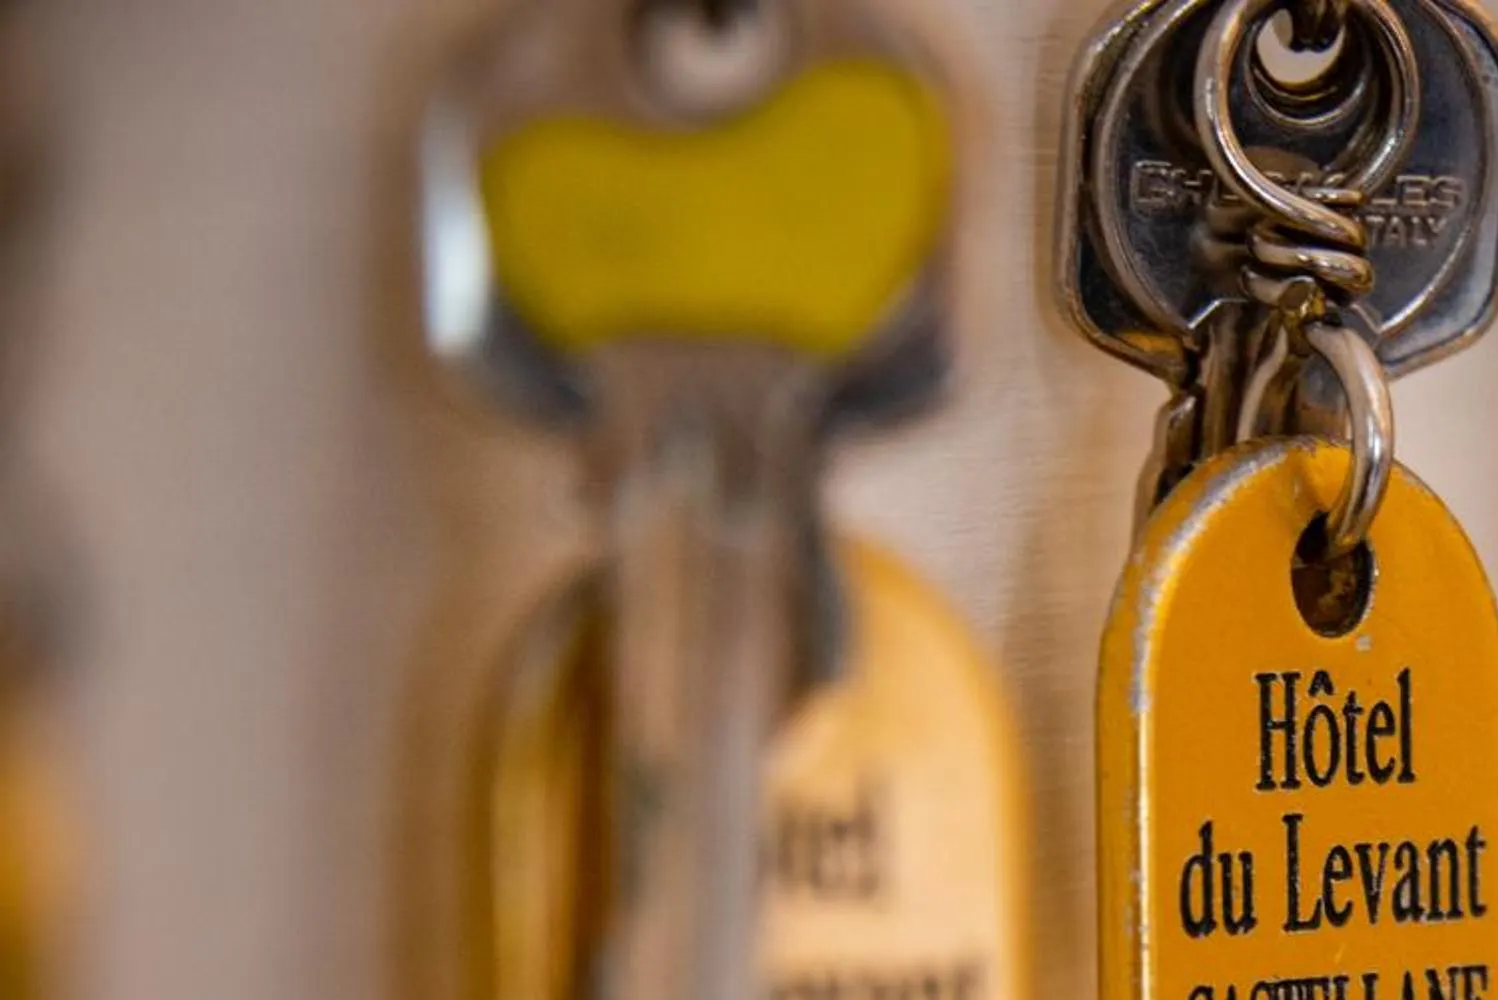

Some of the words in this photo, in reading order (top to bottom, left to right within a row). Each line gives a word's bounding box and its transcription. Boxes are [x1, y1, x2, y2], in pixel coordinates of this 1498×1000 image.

[1355, 214, 1450, 247] TALY
[1255, 667, 1417, 792] Hôtel
[1179, 820, 1258, 939] du
[1282, 813, 1488, 933] Levant
